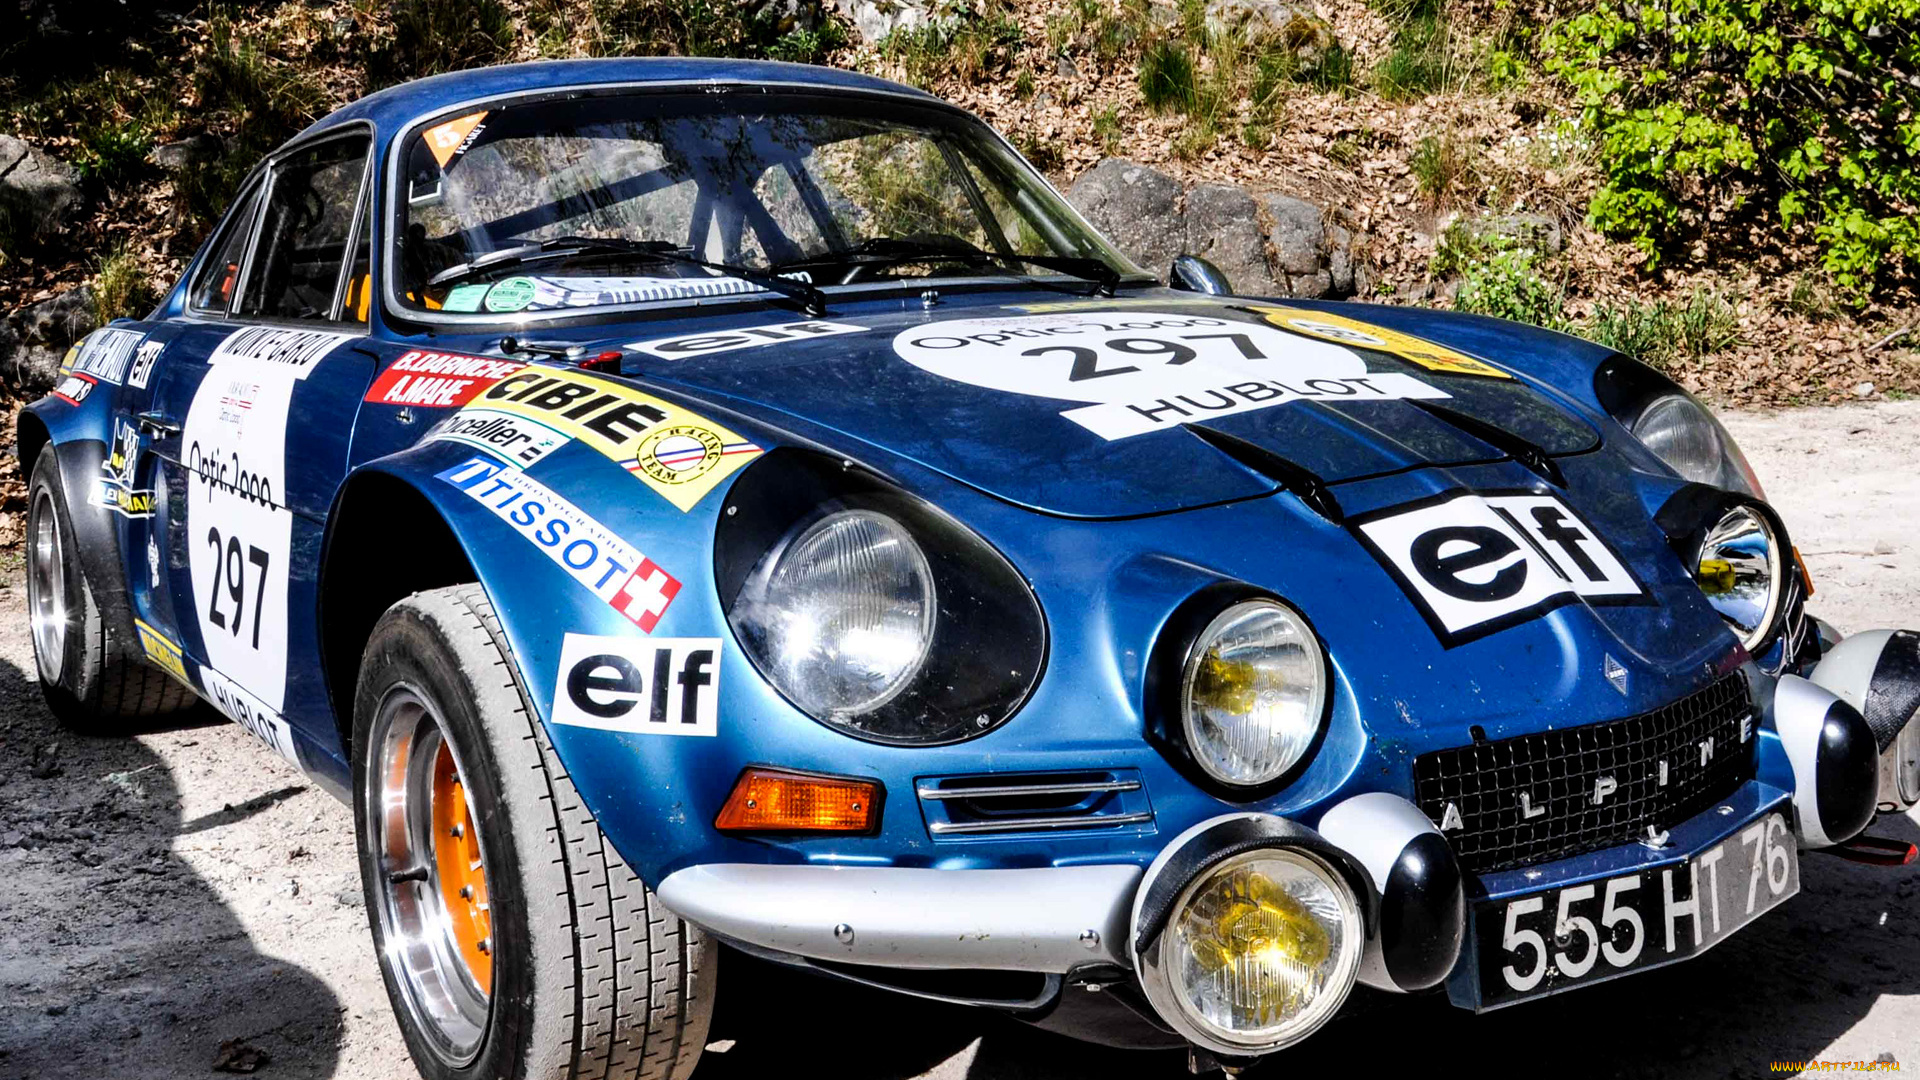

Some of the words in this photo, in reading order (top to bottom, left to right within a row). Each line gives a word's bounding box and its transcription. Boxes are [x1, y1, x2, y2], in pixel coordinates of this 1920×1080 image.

[222, 327, 340, 366] MONTE-CARLO
[654, 323, 836, 351] elf
[1021, 333, 1268, 383] 297
[132, 346, 160, 384] elf
[1126, 378, 1387, 423] HUBLOT
[641, 453, 678, 481] TEAM
[669, 428, 720, 461] RACING
[479, 478, 629, 591] TISSOT
[1409, 505, 1611, 602] elf
[207, 526, 270, 651] 297
[566, 648, 714, 724] elf
[212, 681, 286, 758] HUBLOT
[1502, 874, 1645, 992] 555
[1662, 845, 1724, 953] HT
[1741, 812, 1791, 915] 76
